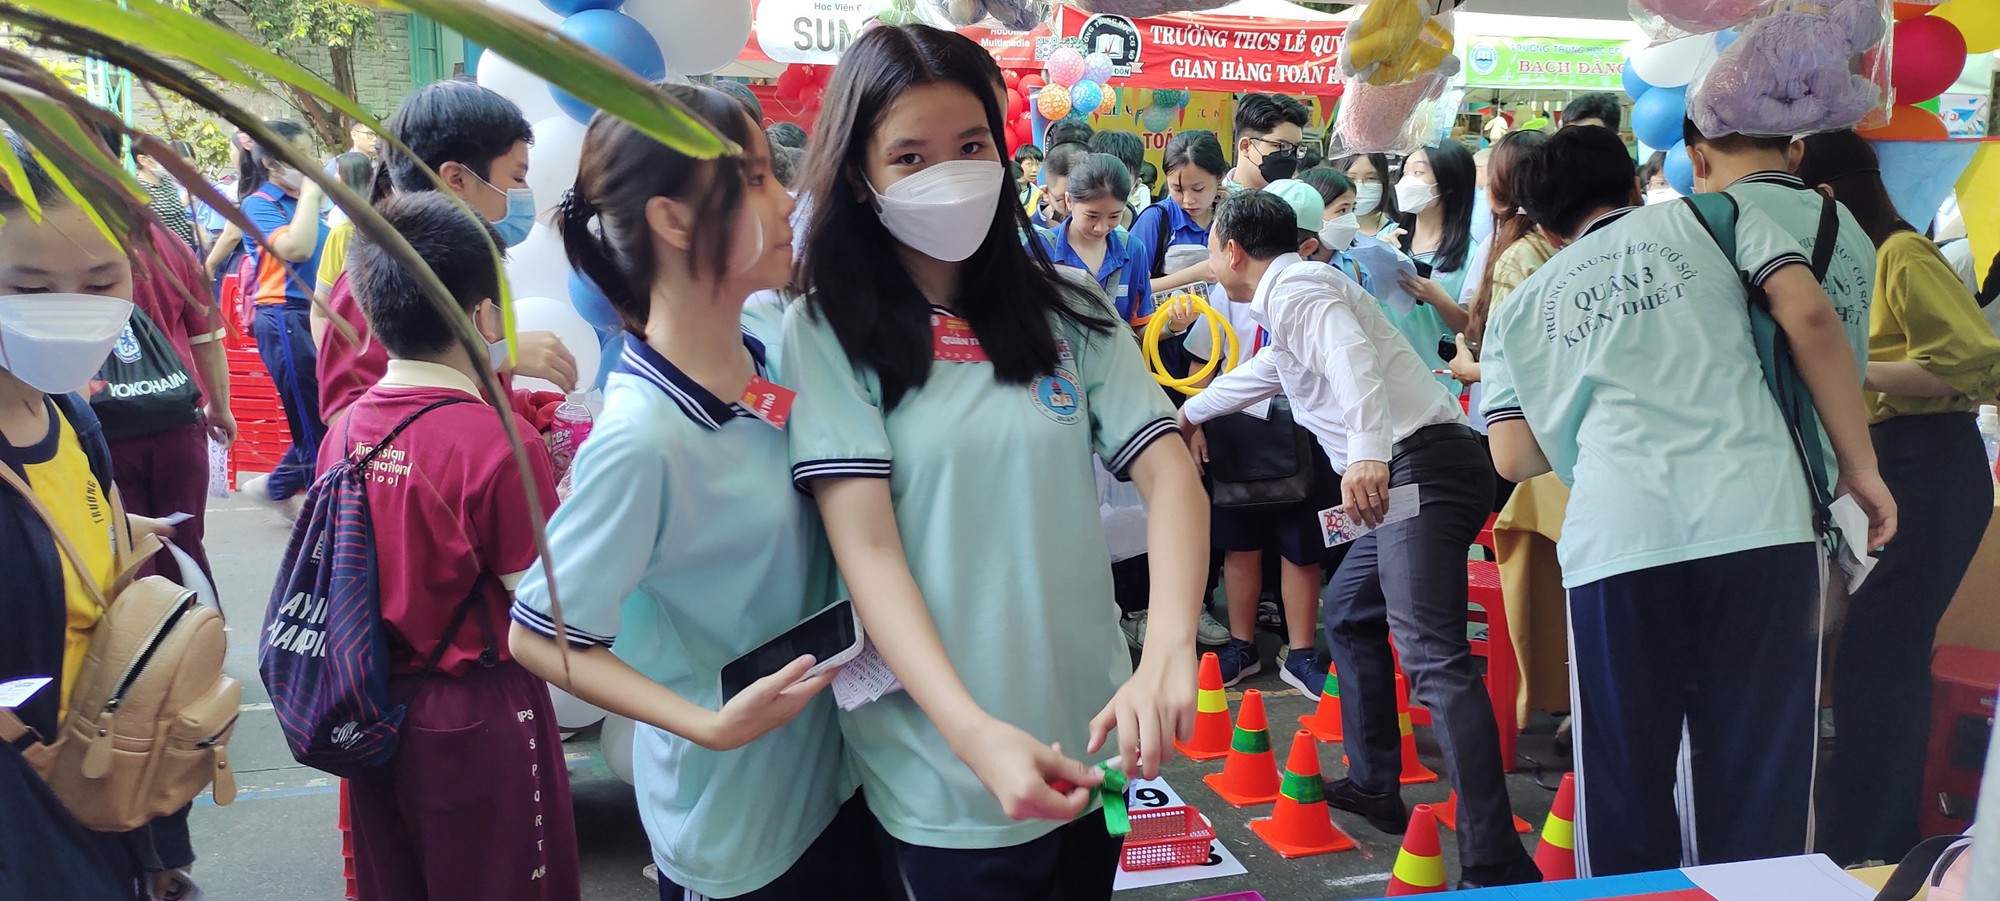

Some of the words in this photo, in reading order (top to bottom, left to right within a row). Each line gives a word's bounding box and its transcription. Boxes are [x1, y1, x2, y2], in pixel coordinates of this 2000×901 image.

[981, 37, 1031, 48] Multimedia
[1150, 24, 1229, 49] TRƯỜNG
[1233, 31, 1281, 52] THCS
[1283, 29, 1307, 53] LÊ
[1170, 58, 1217, 79] GIAN
[1221, 56, 1272, 82] HÀNG
[1276, 60, 1326, 84] TOÁN
[1518, 60, 1571, 76] BẠCH
[1567, 252, 1622, 277] TRUNG
[1626, 242, 1658, 256] HỌC
[1659, 246, 1684, 263] CƠ
[1676, 262, 1698, 281] SỞ
[1574, 274, 1640, 312] QUẬN
[1641, 266, 1654, 284] 3
[1563, 310, 1614, 348] KIẾN
[1617, 283, 1686, 316] THIẾT
[108, 369, 189, 398] YOKOHAMA
